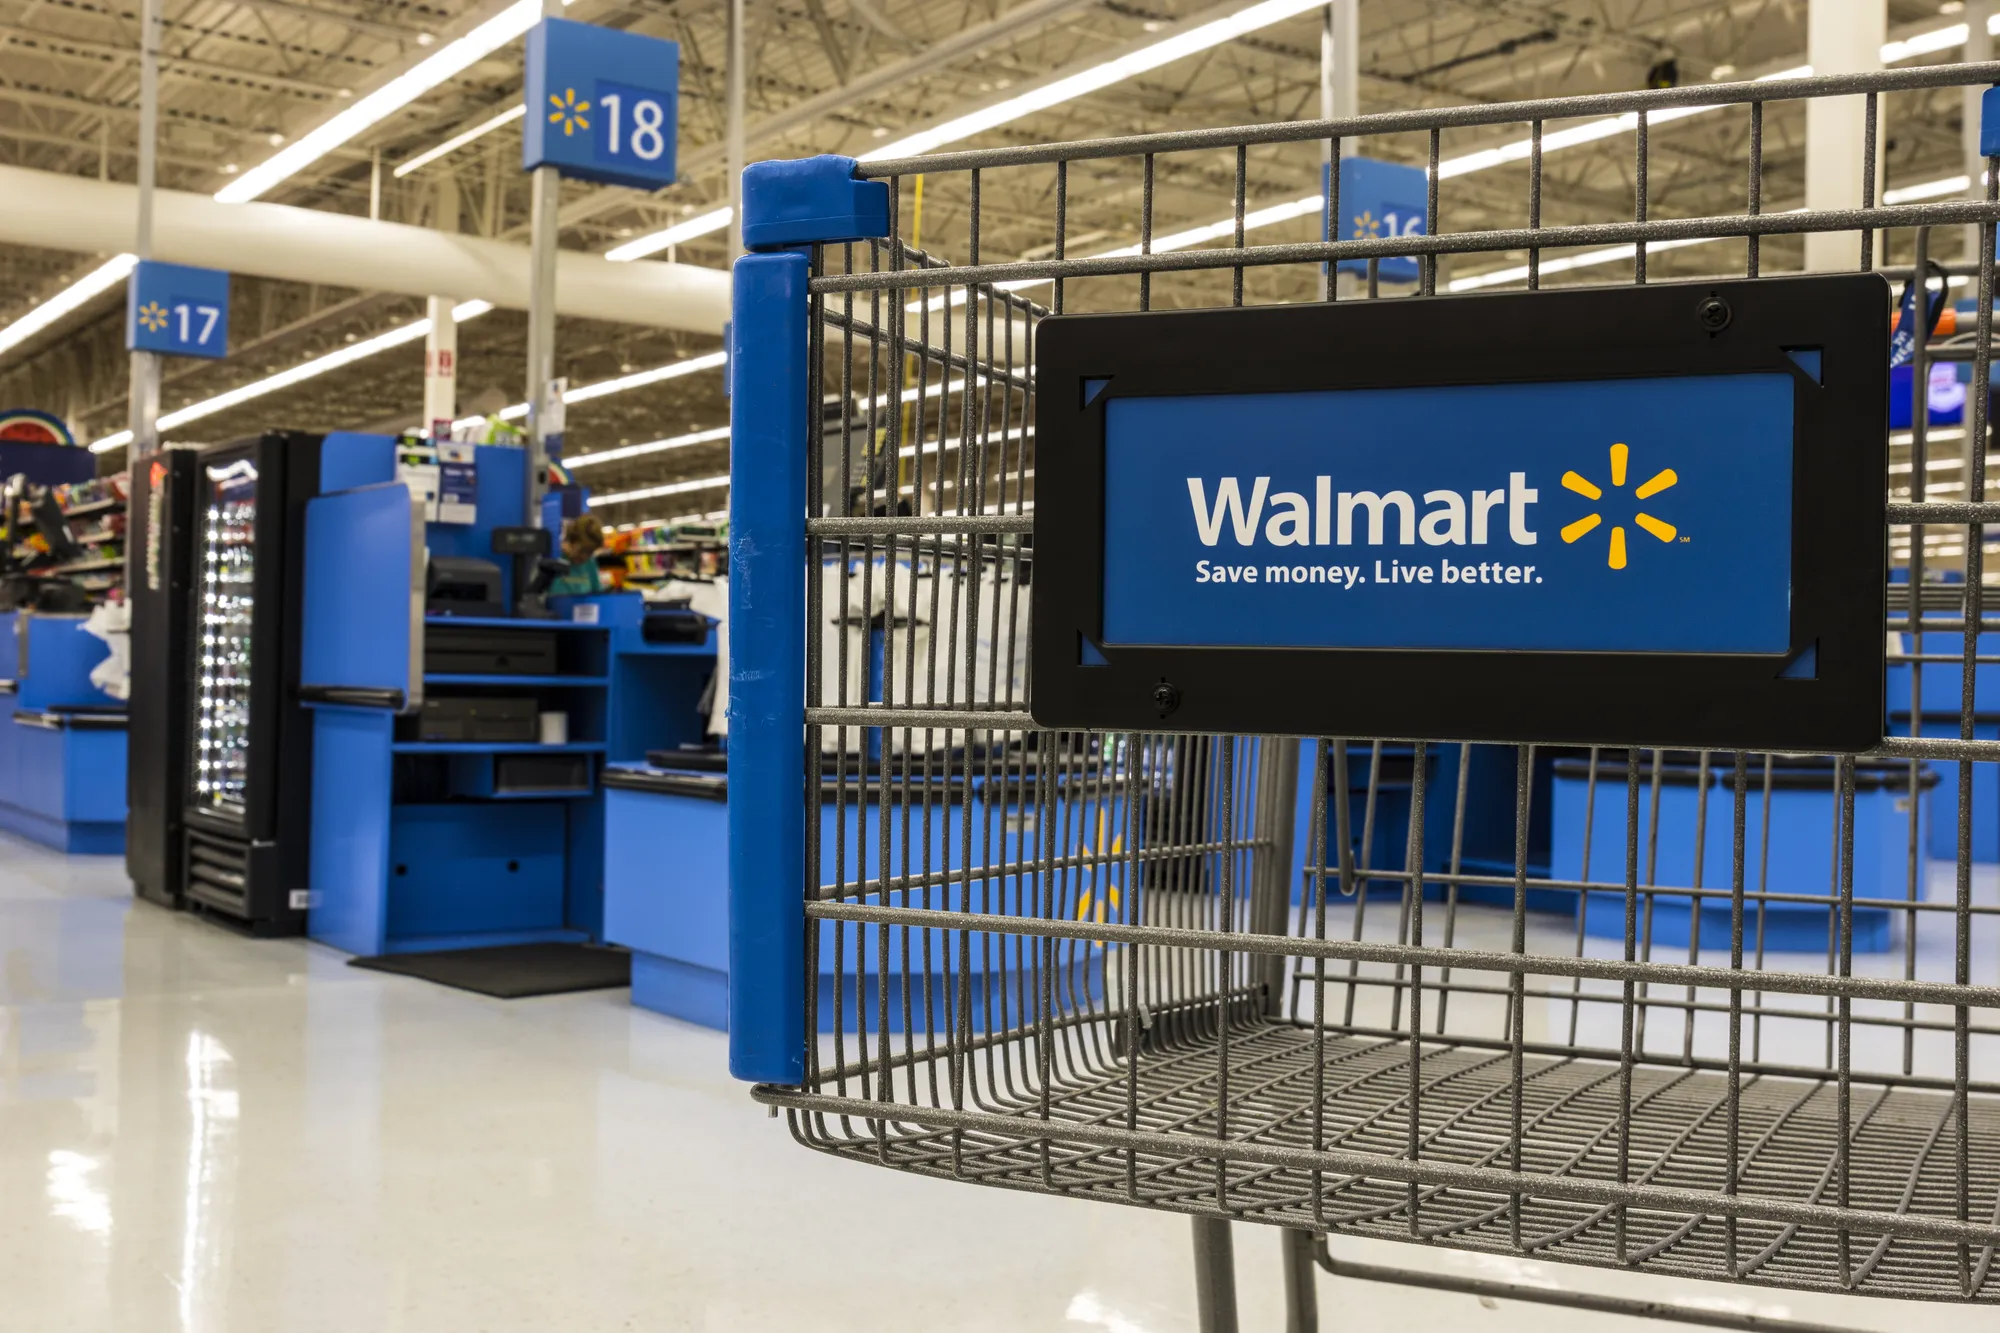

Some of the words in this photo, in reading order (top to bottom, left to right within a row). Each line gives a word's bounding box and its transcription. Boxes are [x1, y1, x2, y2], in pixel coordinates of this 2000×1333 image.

[600, 94, 664, 160] 18
[175, 304, 220, 345] 17
[1187, 472, 1539, 547] Walmart
[1195, 559, 1259, 583] Save
[1266, 565, 1366, 590] money.
[1375, 560, 1434, 584] Live
[1441, 558, 1543, 584] better.
